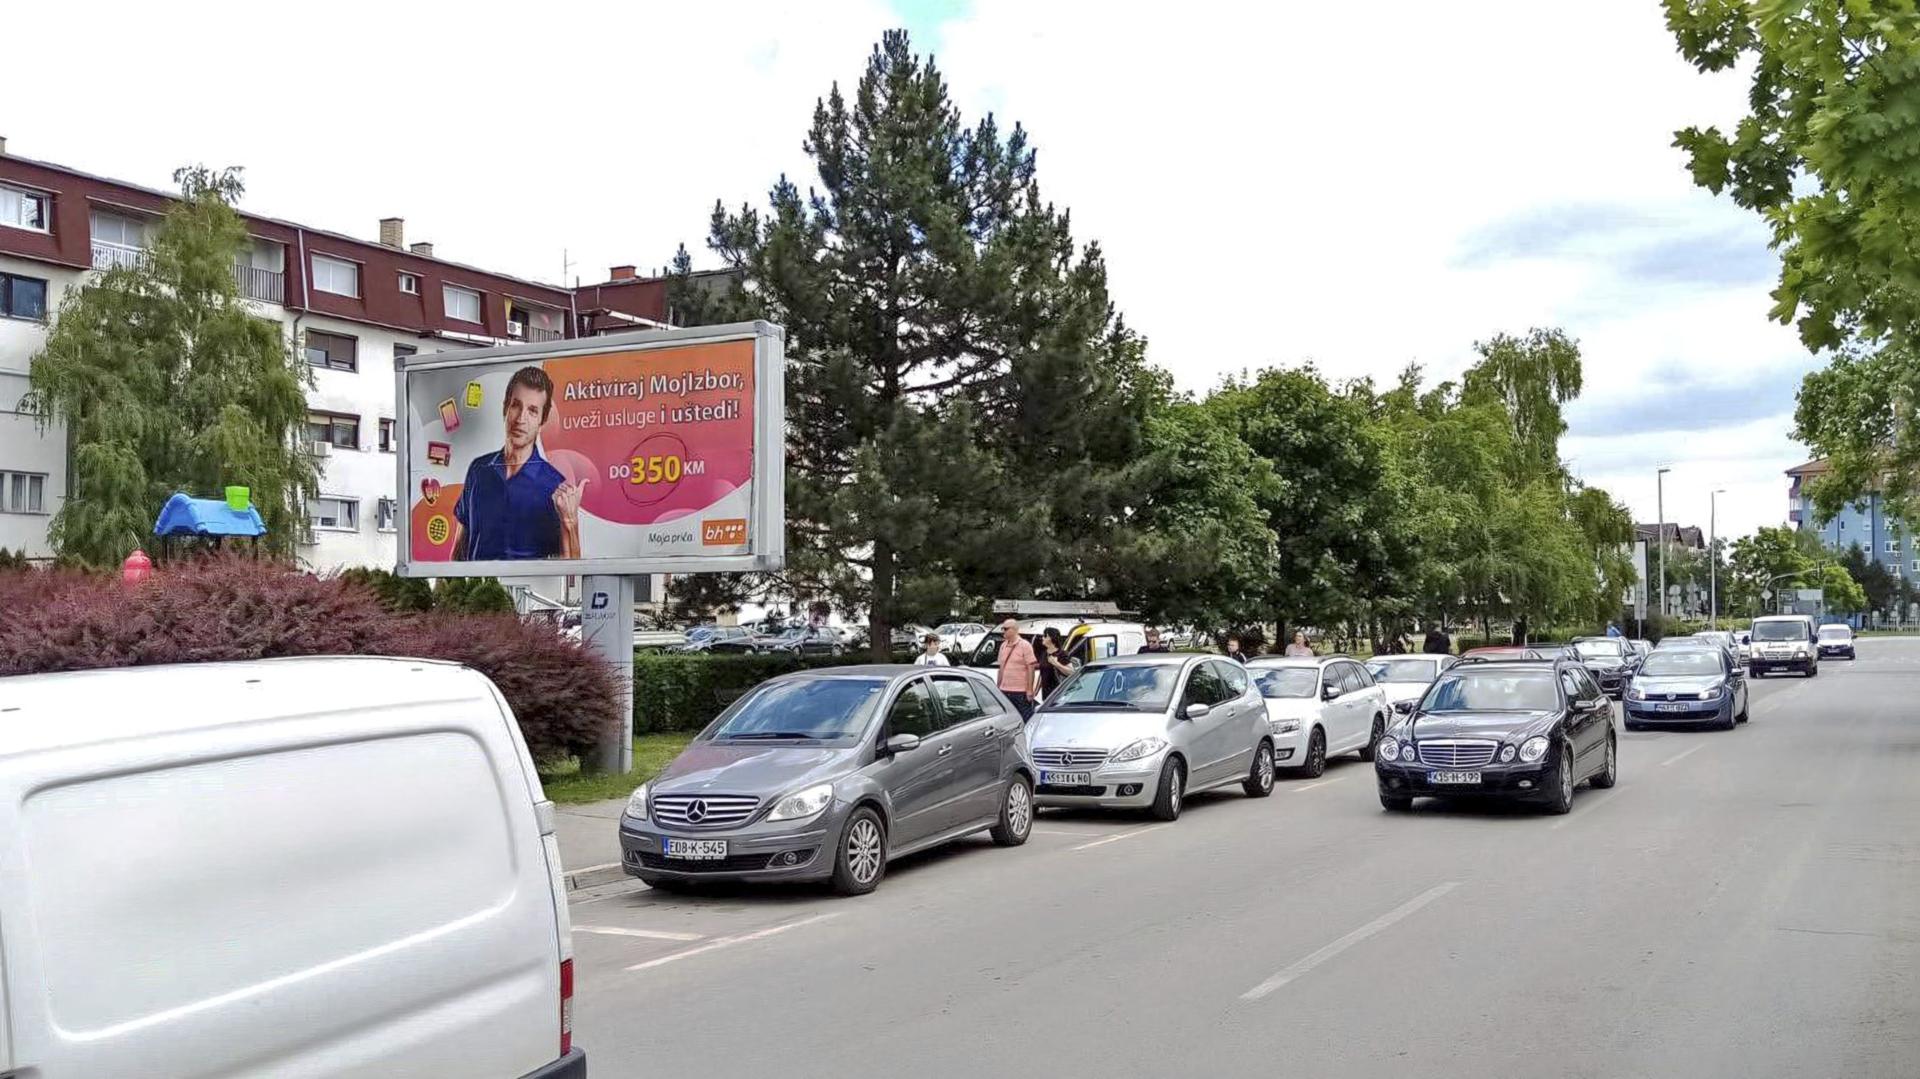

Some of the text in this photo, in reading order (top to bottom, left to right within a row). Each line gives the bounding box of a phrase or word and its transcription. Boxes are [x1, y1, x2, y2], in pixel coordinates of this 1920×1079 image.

[564, 376, 645, 401] Aktiviraj
[563, 400, 739, 430] uveži usluge i uštedi!
[609, 455, 705, 485] DO 350 KM
